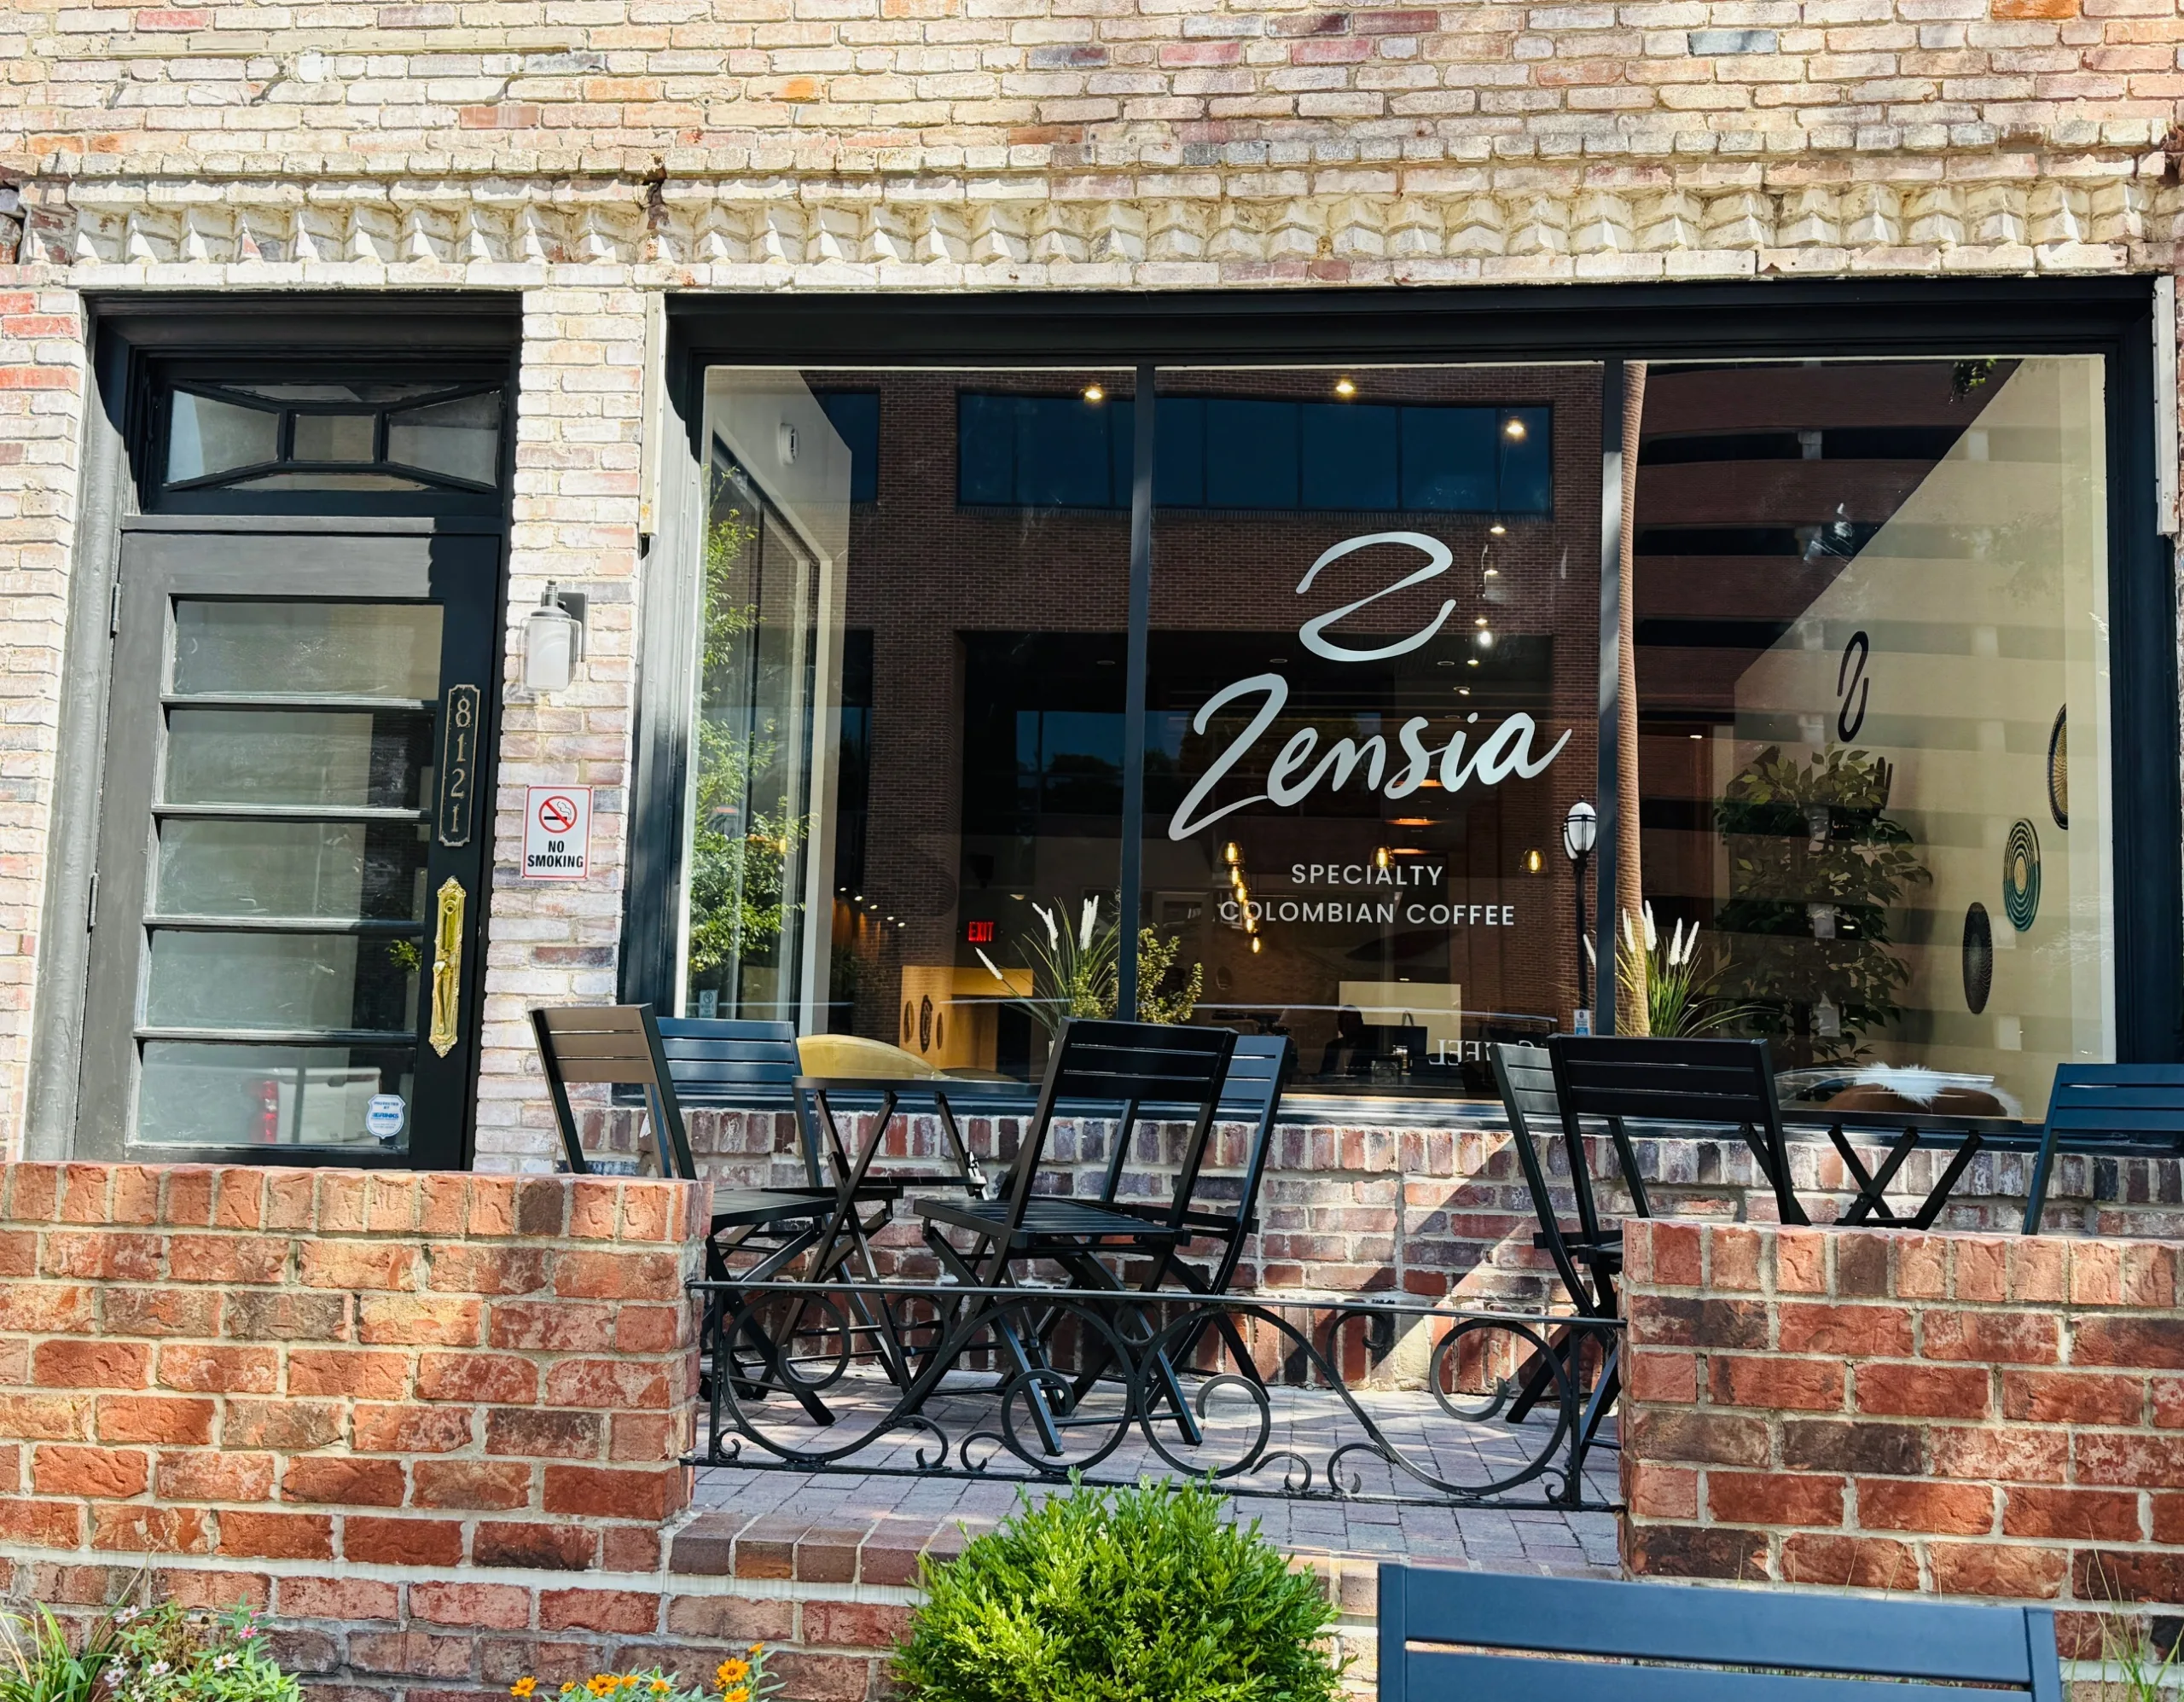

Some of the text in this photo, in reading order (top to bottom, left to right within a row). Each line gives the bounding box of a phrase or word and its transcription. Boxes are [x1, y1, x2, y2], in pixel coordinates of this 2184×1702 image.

[450, 695, 472, 834] 8121
[1168, 672, 1572, 841] Zensia
[548, 840, 565, 853] NO
[527, 854, 584, 868] SMOKING
[1291, 863, 1443, 886] SPECIALTY
[1220, 900, 1515, 927] COLOMBIAN COFFEE
[968, 921, 994, 942] EXIT
